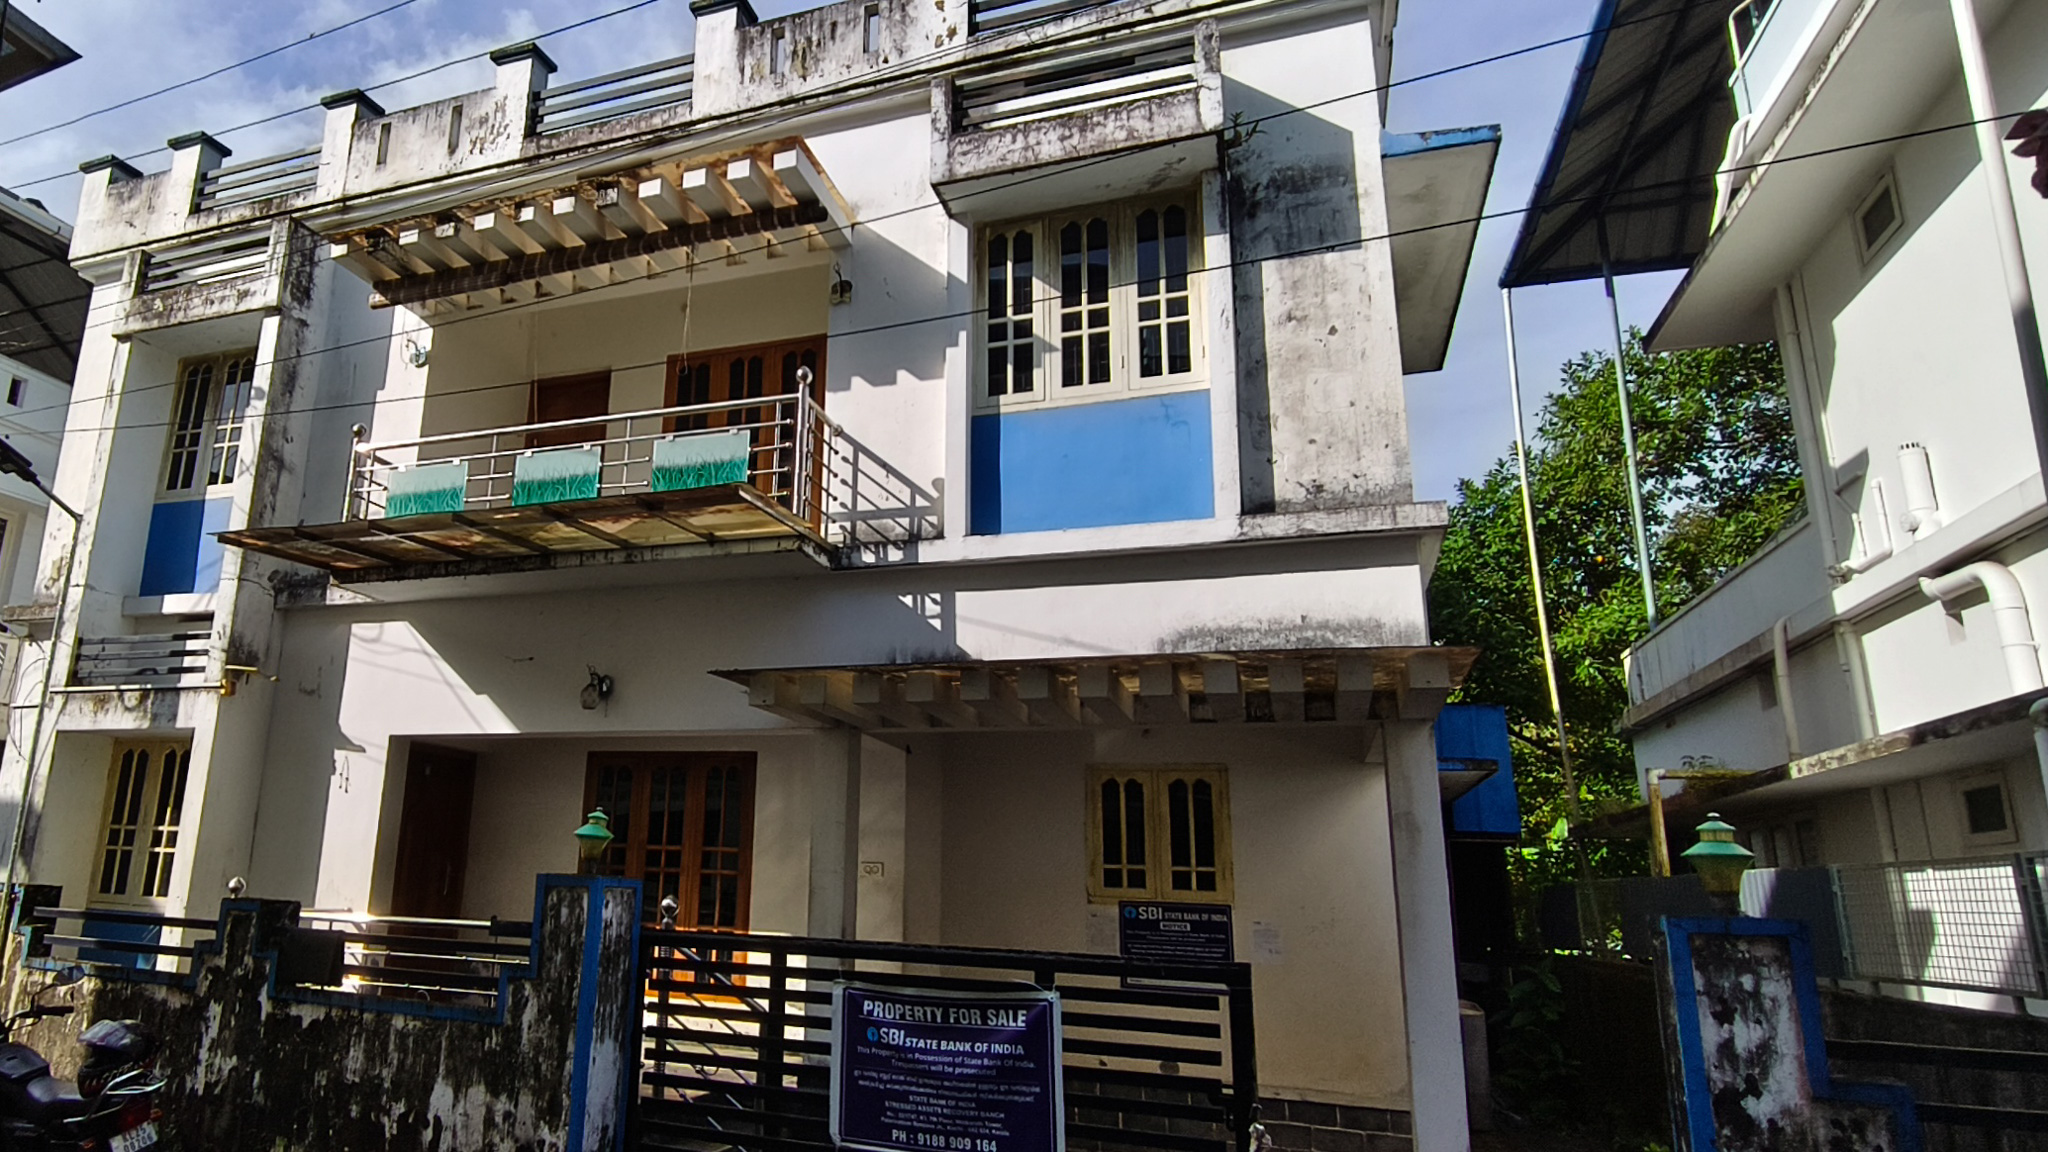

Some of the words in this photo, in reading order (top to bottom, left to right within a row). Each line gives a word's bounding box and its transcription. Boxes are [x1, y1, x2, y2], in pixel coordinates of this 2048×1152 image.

[1138, 906, 1162, 920] SBI
[863, 1000, 943, 1023] PROPERTY
[949, 1008, 982, 1025] FOR
[987, 1009, 1027, 1027] SALE
[880, 1027, 905, 1046] SBI
[905, 1037, 938, 1050] STATE
[940, 1041, 972, 1052] BANK
[974, 1043, 989, 1053] OF
[991, 1043, 1024, 1055] INDIA
[857, 1046, 870, 1054] This
[872, 1047, 899, 1059] Property
[914, 1053, 953, 1063] Possession
[964, 1057, 982, 1065] State
[983, 1058, 1001, 1066] Bank
[944, 1065, 953, 1073] be
[909, 1095, 928, 1103] STATE
[929, 1097, 946, 1105] BANK
[892, 1129, 907, 1142] PH
[917, 1133, 946, 1147] 9188
[949, 1136, 971, 1150] 909
[976, 1139, 997, 1152] 164
